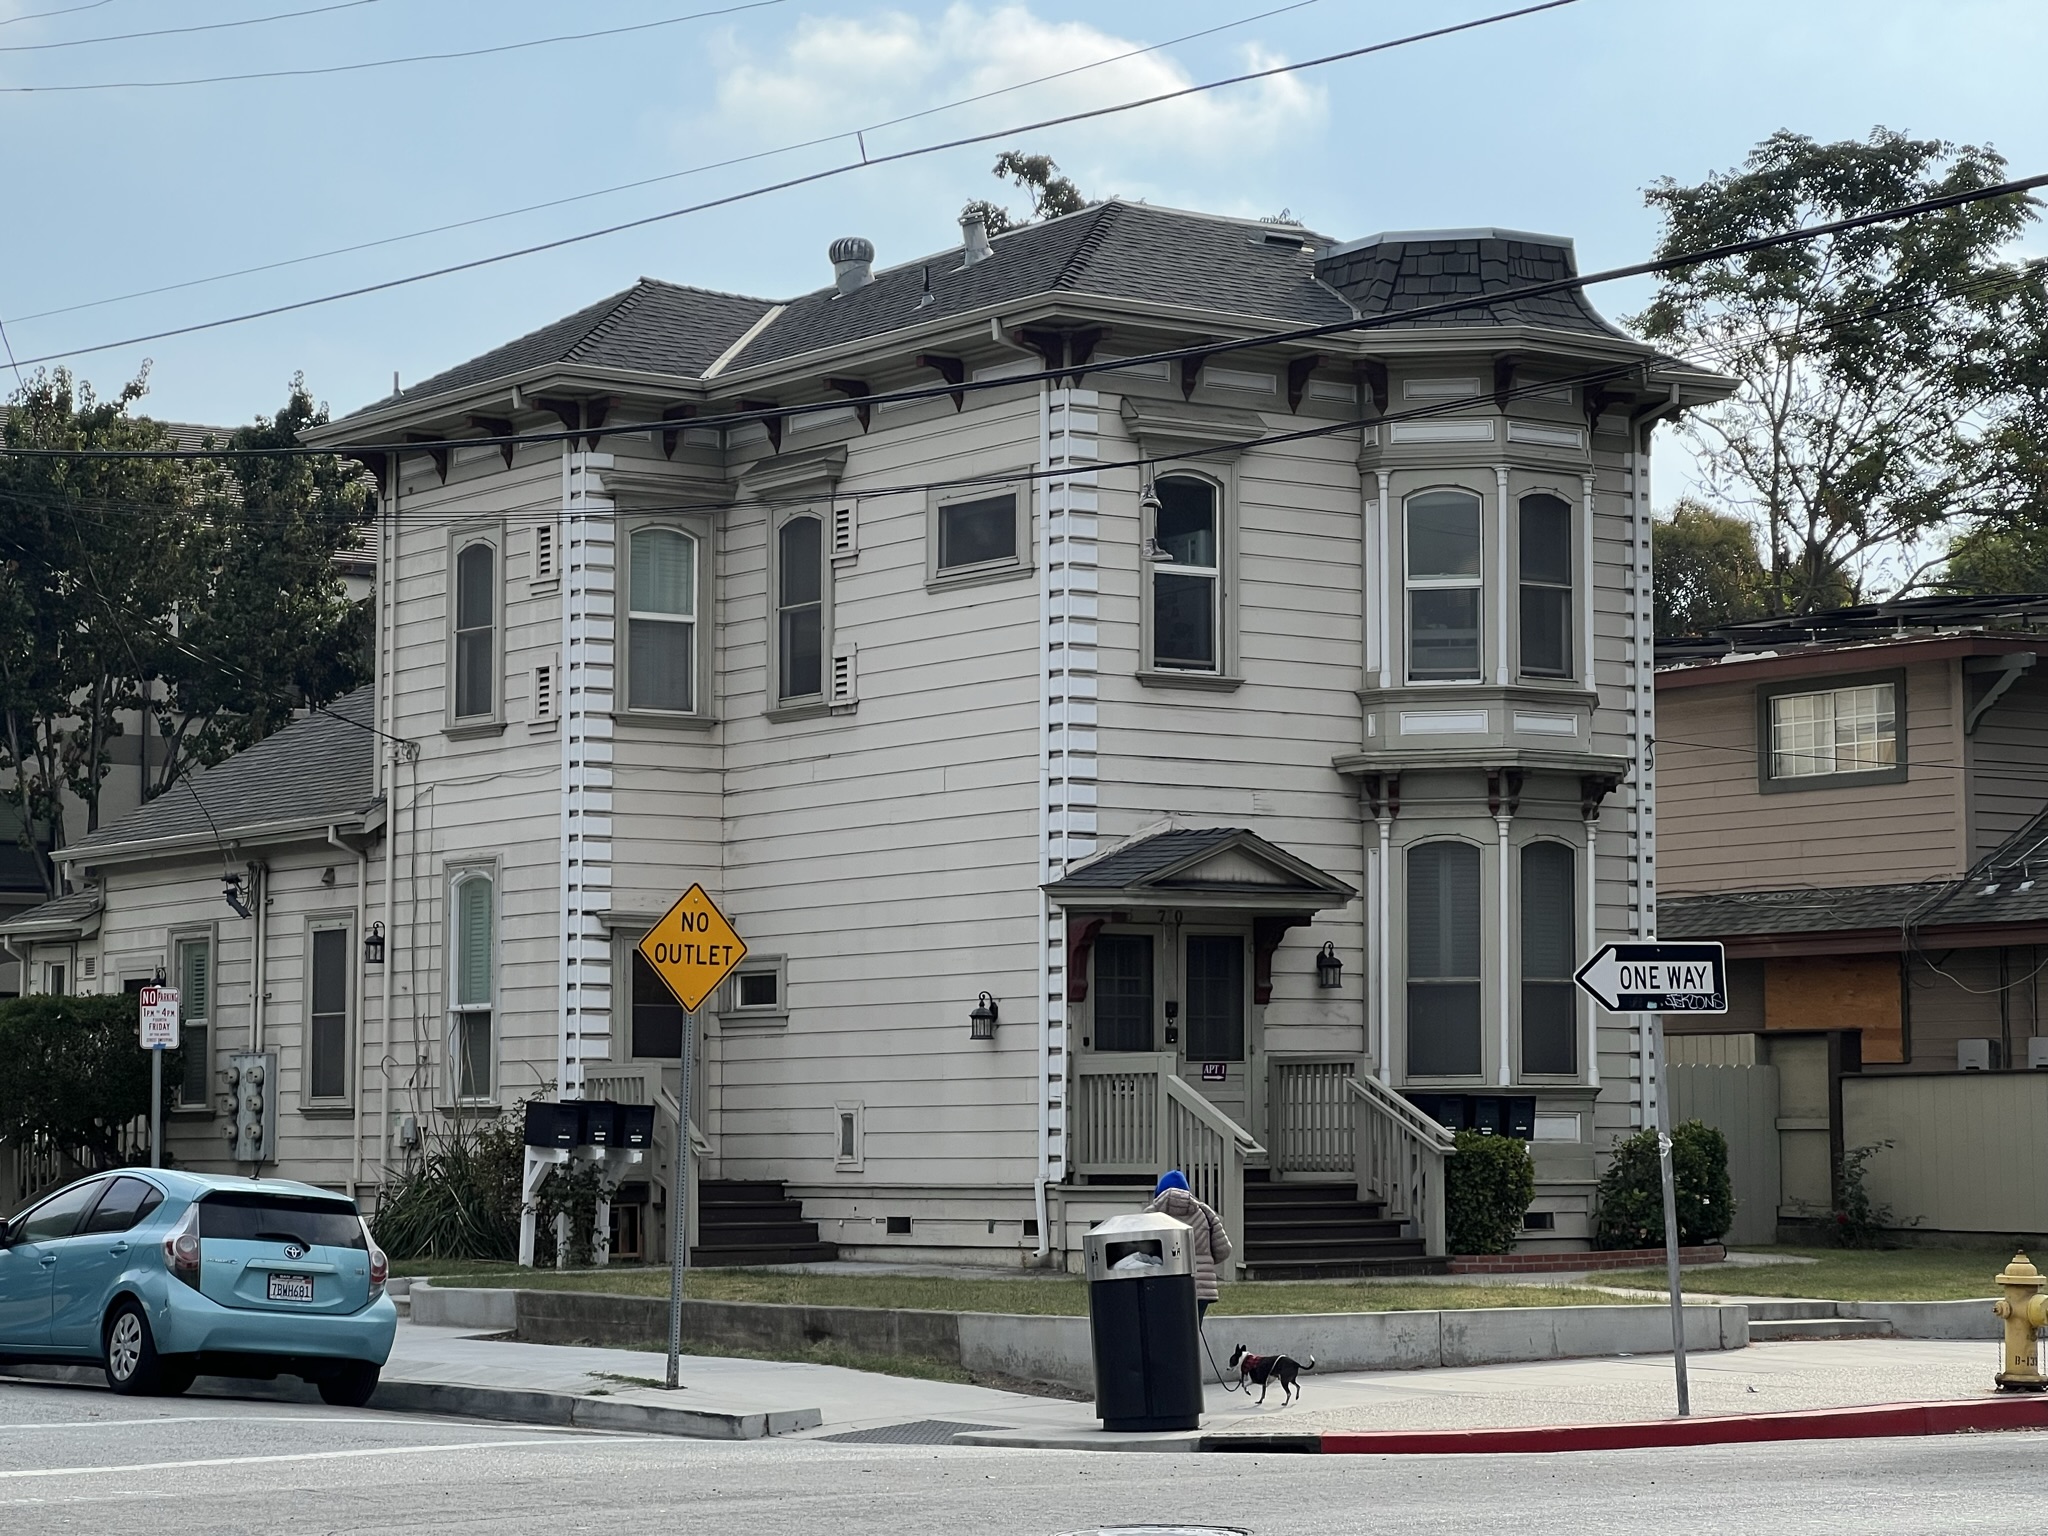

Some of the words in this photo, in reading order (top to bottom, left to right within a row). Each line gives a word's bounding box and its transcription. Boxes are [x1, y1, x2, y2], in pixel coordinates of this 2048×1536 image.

[681, 911, 709, 932] NO
[654, 942, 733, 966] OUTLET
[1620, 965, 1661, 990] ONE
[1667, 965, 1707, 990] WAY
[142, 990, 156, 1005] NO
[158, 992, 178, 1002] PARKING
[143, 1007, 156, 1017] 1PM
[161, 1007, 176, 1017] 4PM
[148, 1022, 171, 1031] FRIDAY
[1203, 1064, 1220, 1074] APT
[1221, 1065, 1225, 1074] 1
[271, 1283, 310, 1298] 7BWH681
